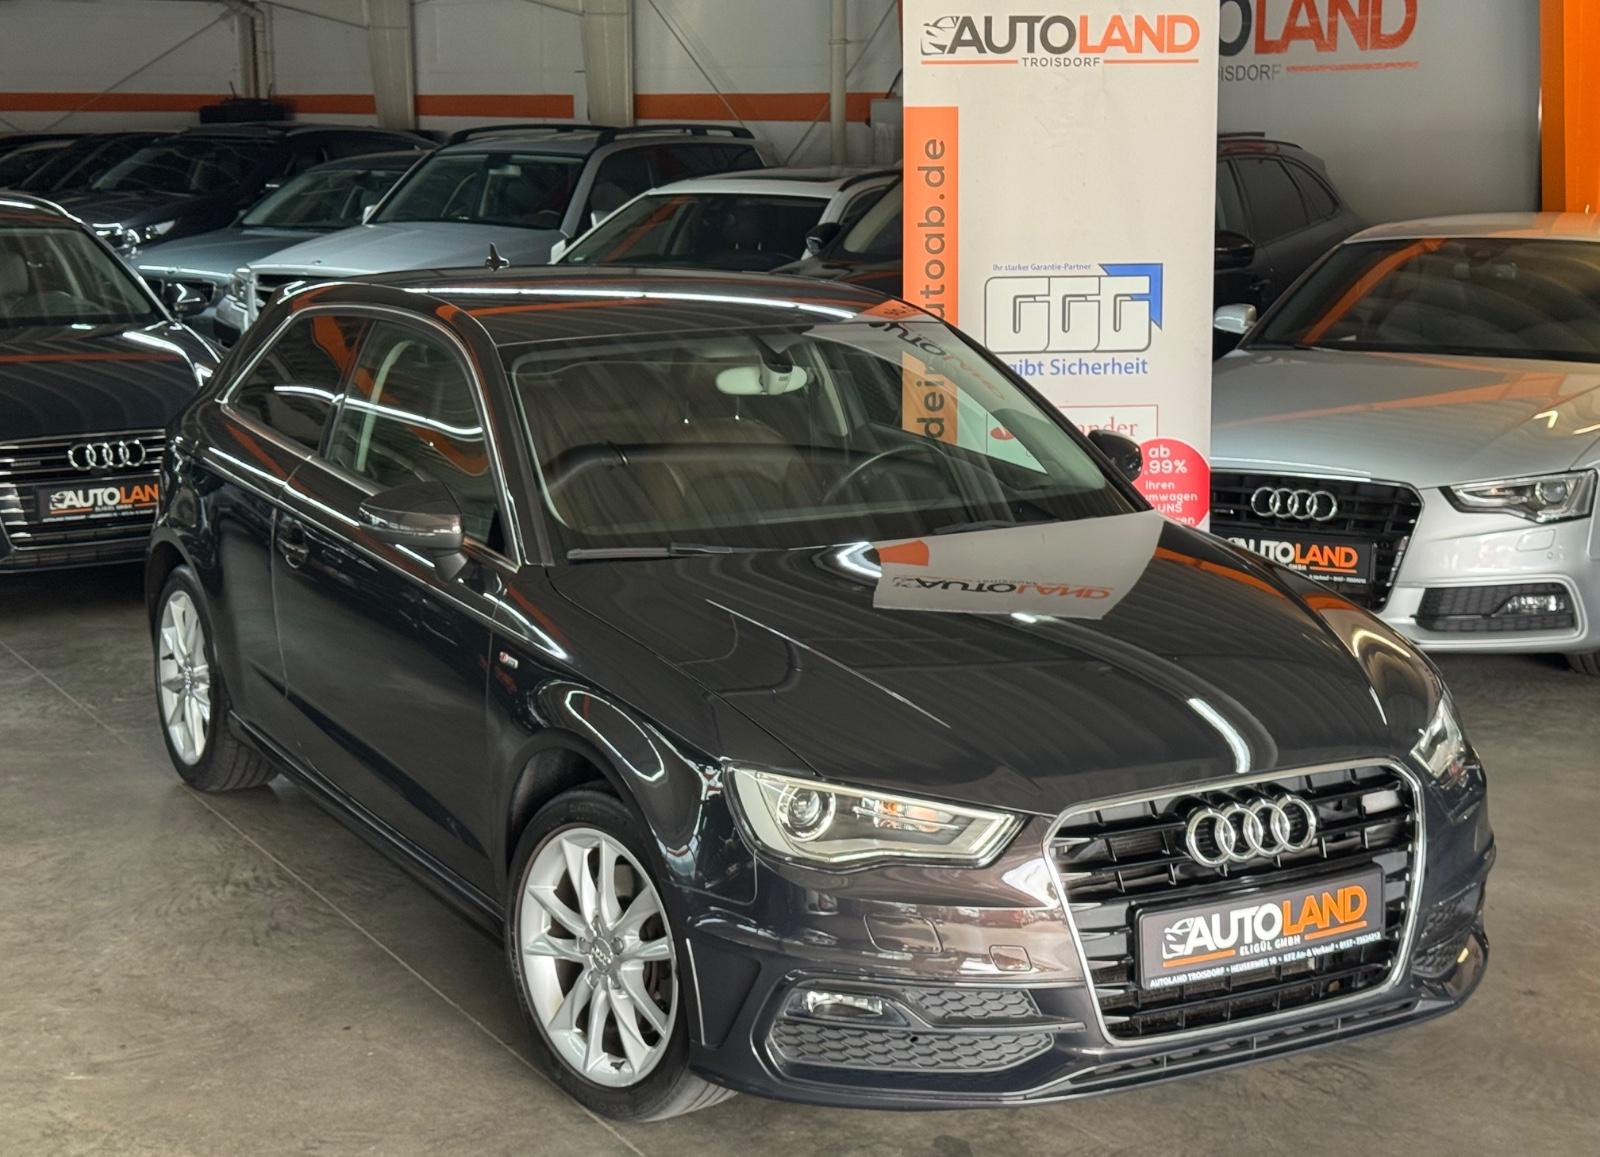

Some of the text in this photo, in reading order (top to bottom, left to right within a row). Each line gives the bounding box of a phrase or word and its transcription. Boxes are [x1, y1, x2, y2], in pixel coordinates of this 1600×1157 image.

[947, 15, 1200, 54] AUTOLAND
[1022, 57, 1100, 68] TROISDORF
[1050, 357, 1149, 376] Sicherheit
[1149, 445, 1170, 458] ab
[1184, 885, 1368, 955] AUTOLAND
[1275, 935, 1301, 949] GMBH
[1150, 974, 1187, 988] AUTOLAND
[1188, 966, 1225, 981] TROISDORF
